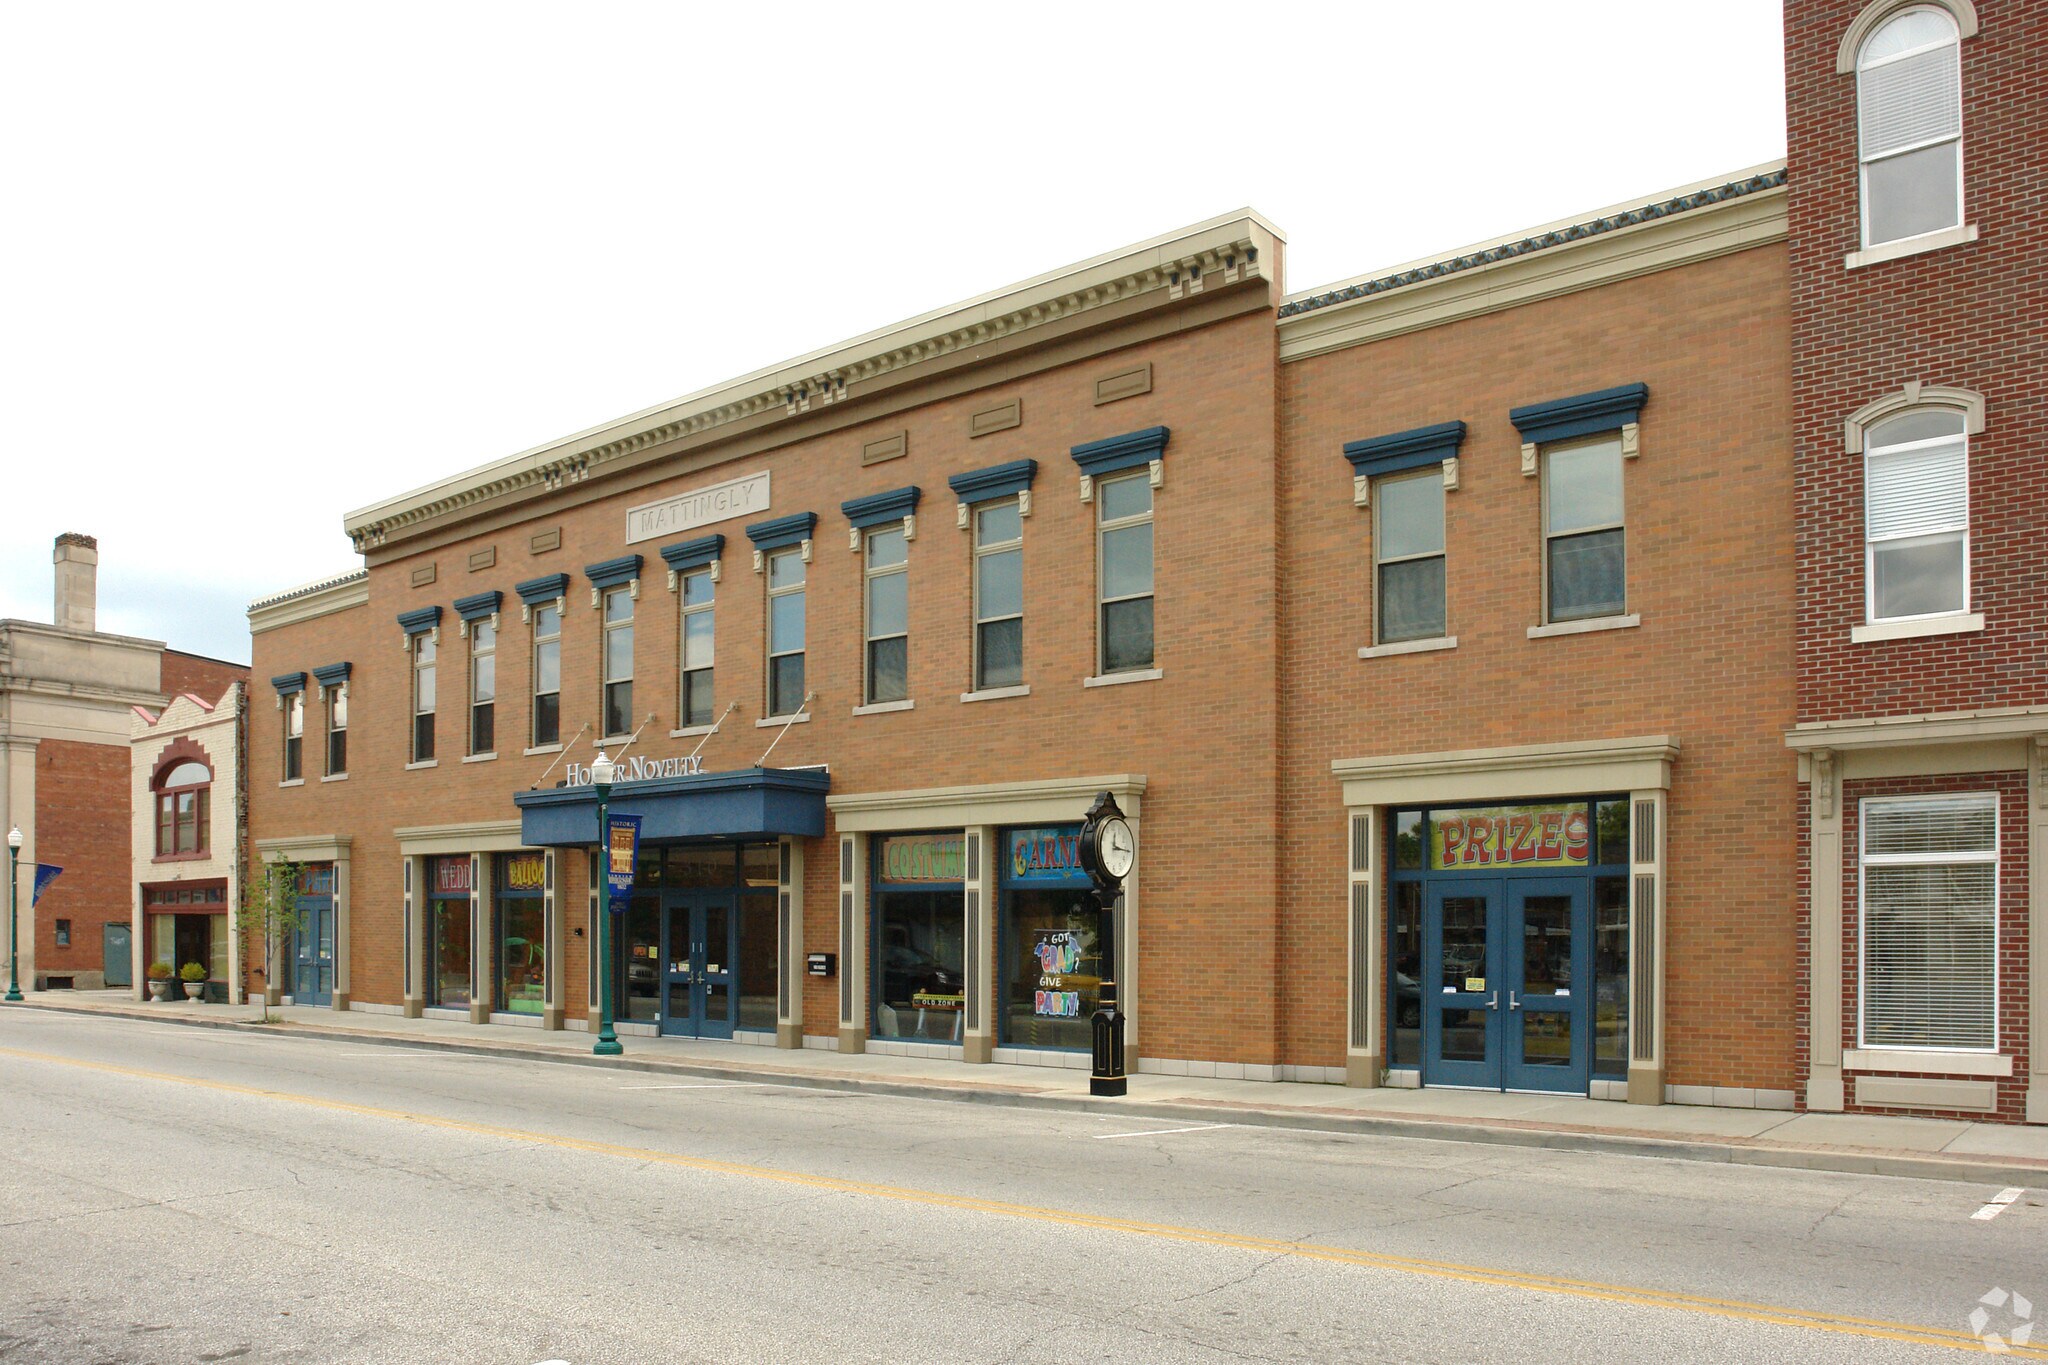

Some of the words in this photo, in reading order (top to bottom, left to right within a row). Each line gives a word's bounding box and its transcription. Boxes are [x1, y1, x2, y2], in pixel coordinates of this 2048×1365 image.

[641, 483, 755, 533] MATTINGLY
[566, 763, 626, 787] HOER
[629, 755, 703, 781] NOVELTY
[1439, 812, 1588, 867] PRIZES
[1051, 932, 1070, 944] GOT
[1040, 977, 1061, 987] GIVE
[1035, 991, 1079, 1016] PARTY!
